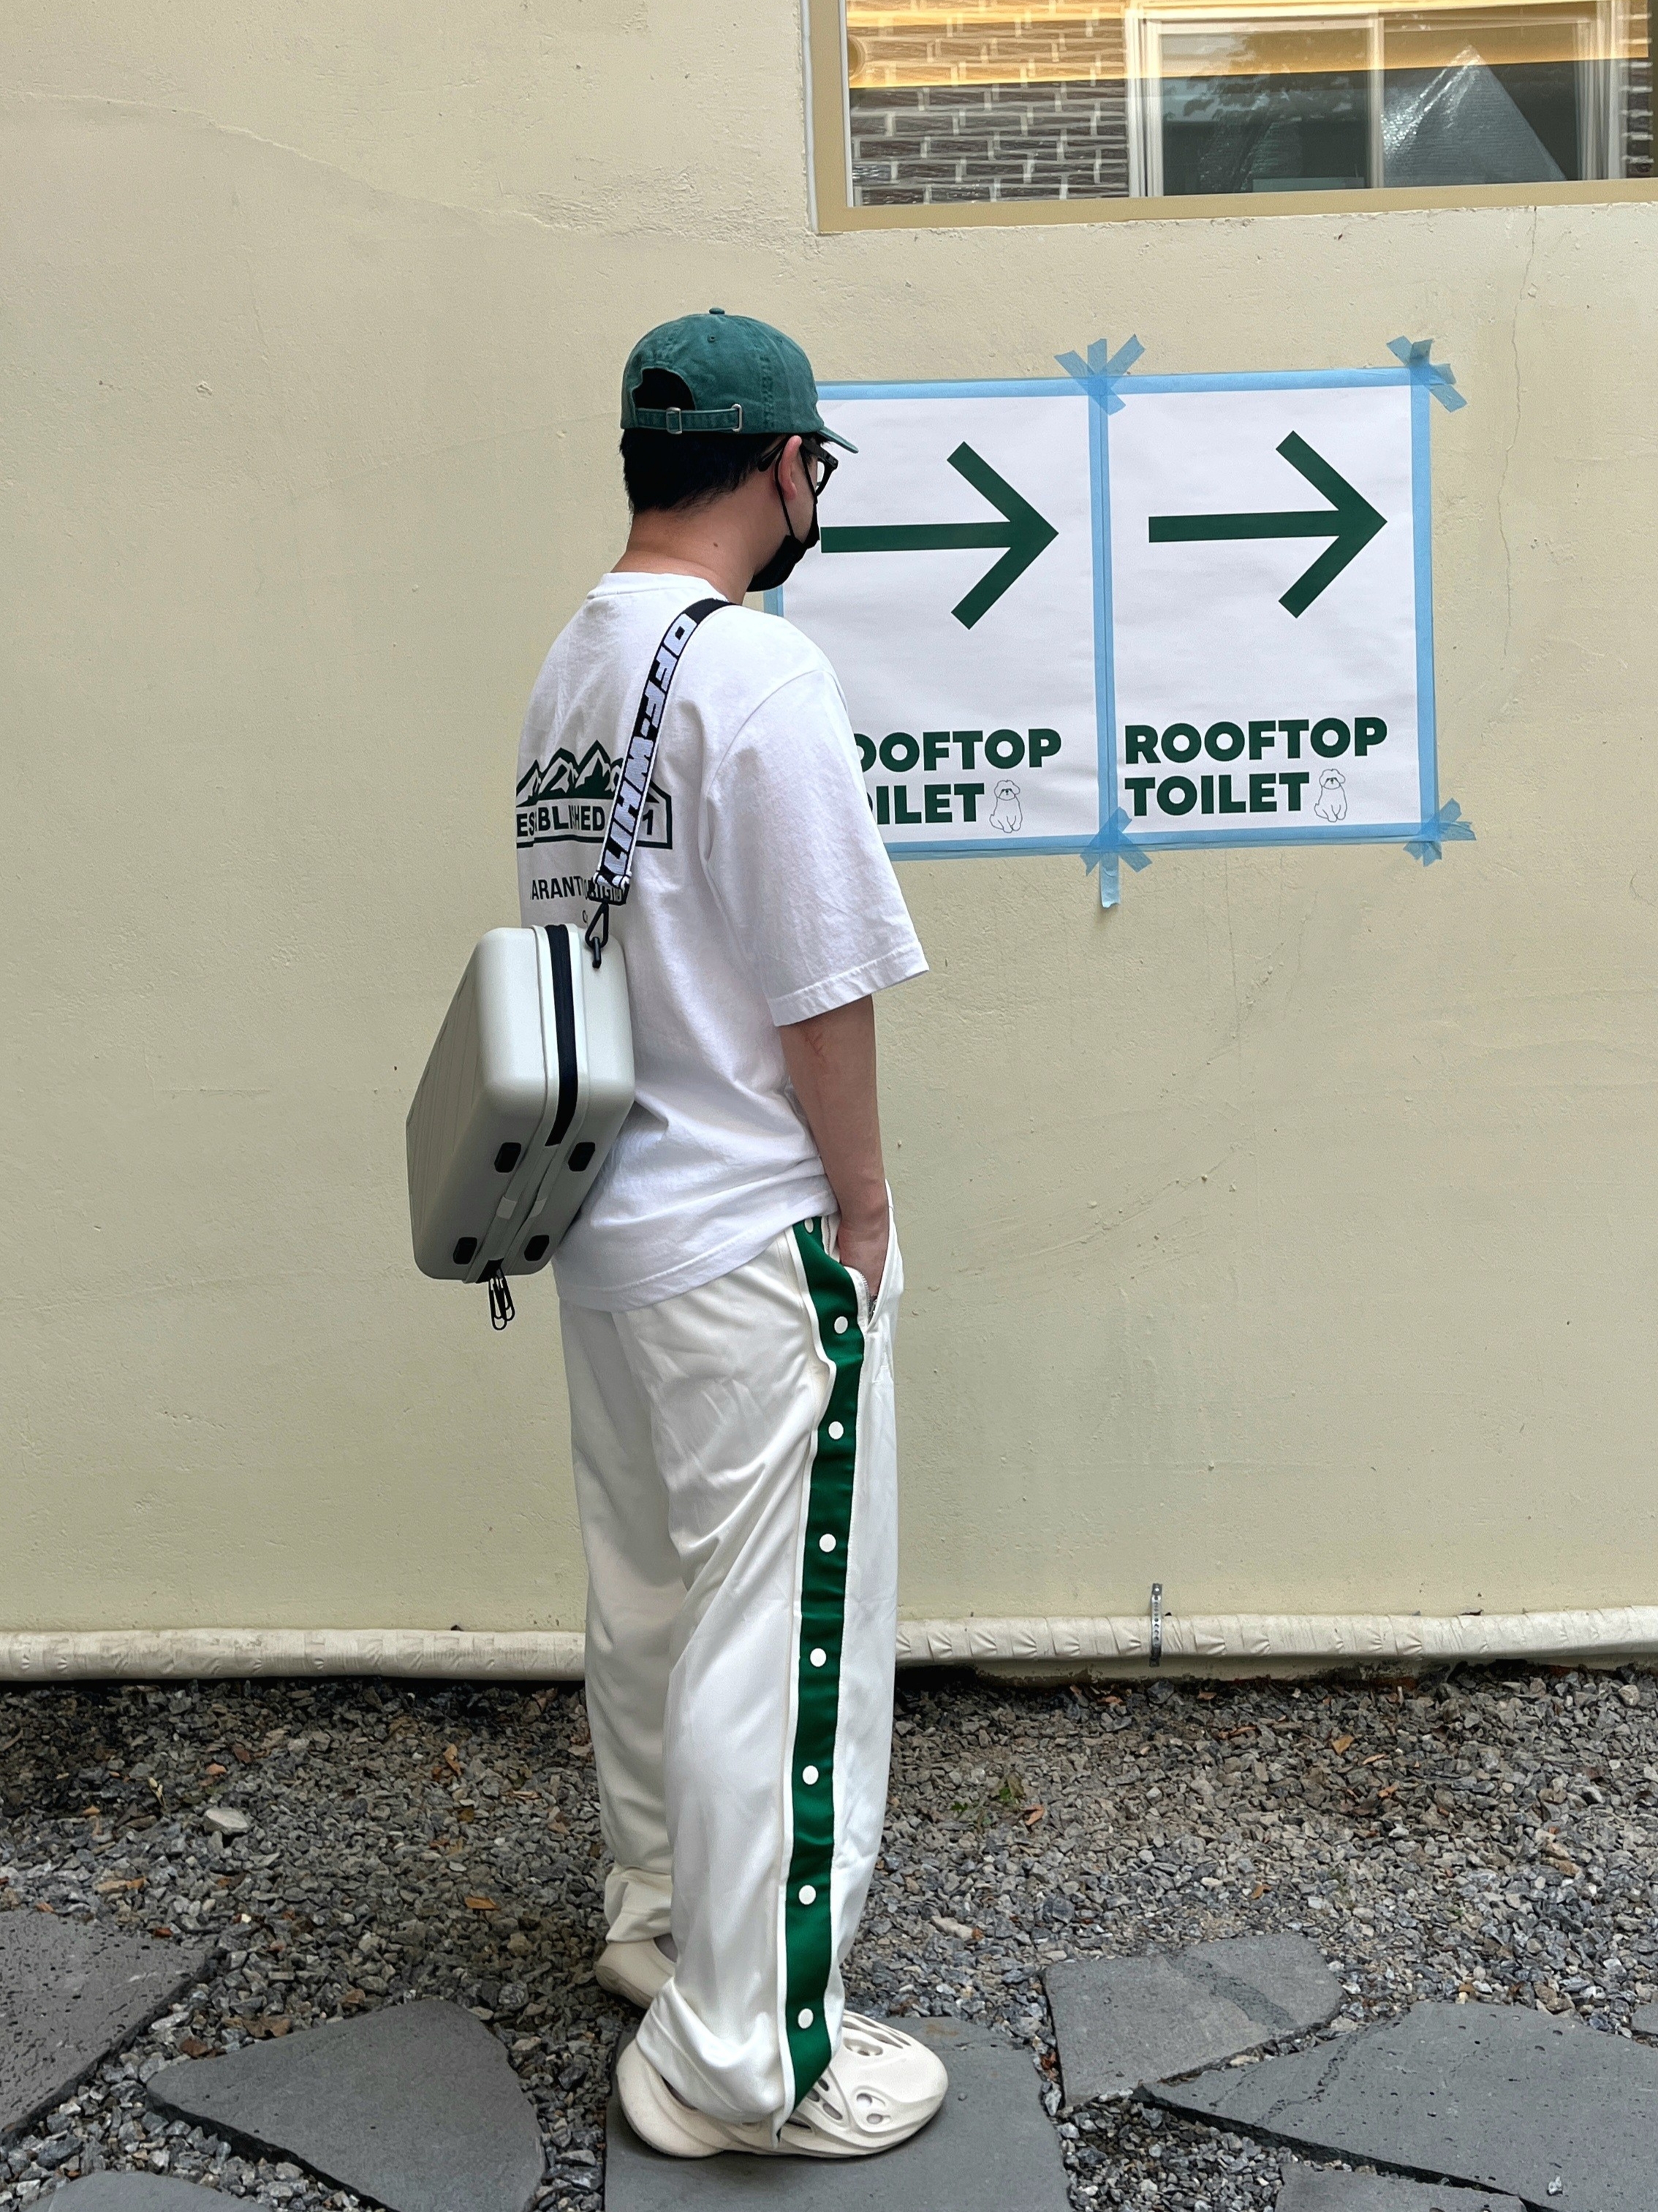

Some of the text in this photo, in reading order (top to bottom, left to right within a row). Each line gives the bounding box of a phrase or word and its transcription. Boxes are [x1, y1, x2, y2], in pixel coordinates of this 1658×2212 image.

[1124, 717, 1388, 765] ROOFTOP
[866, 782, 985, 825] ILET
[1124, 771, 1310, 817] TOILET
